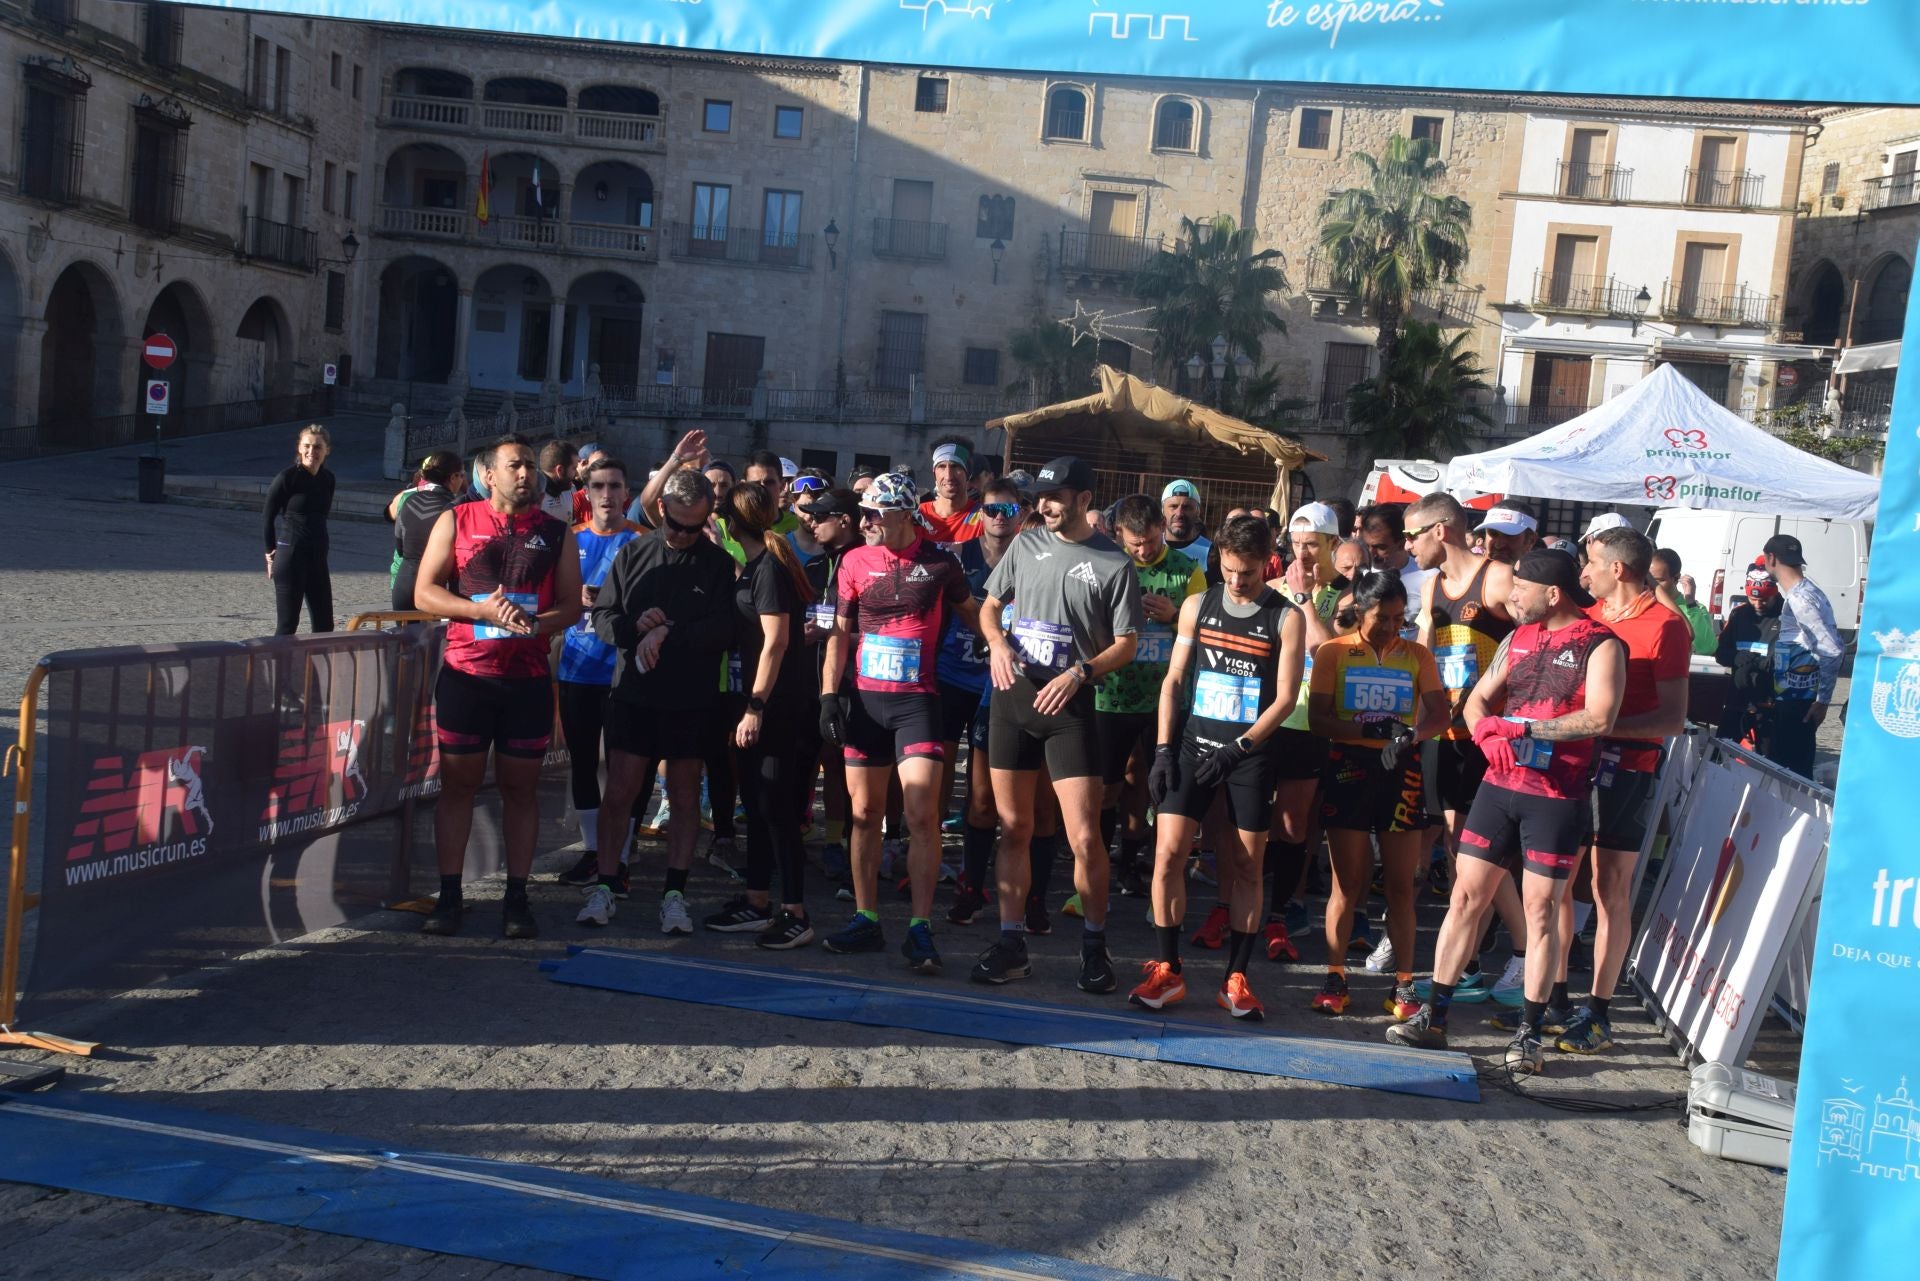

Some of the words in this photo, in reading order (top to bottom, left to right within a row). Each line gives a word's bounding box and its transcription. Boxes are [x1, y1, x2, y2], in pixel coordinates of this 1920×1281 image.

[1646, 449, 1732, 460] primaflor
[1679, 483, 1761, 501] primaflor
[867, 651, 904, 681] 545
[1017, 636, 1055, 667] 208
[1224, 656, 1258, 673] VICKY
[1226, 666, 1254, 678] FOODS
[1201, 689, 1241, 722] 500
[1354, 683, 1397, 712] 565
[259, 802, 359, 842] www.musicrun.es
[65, 837, 206, 886] www.musicrun.es
[1876, 952, 1912, 968] QUE
